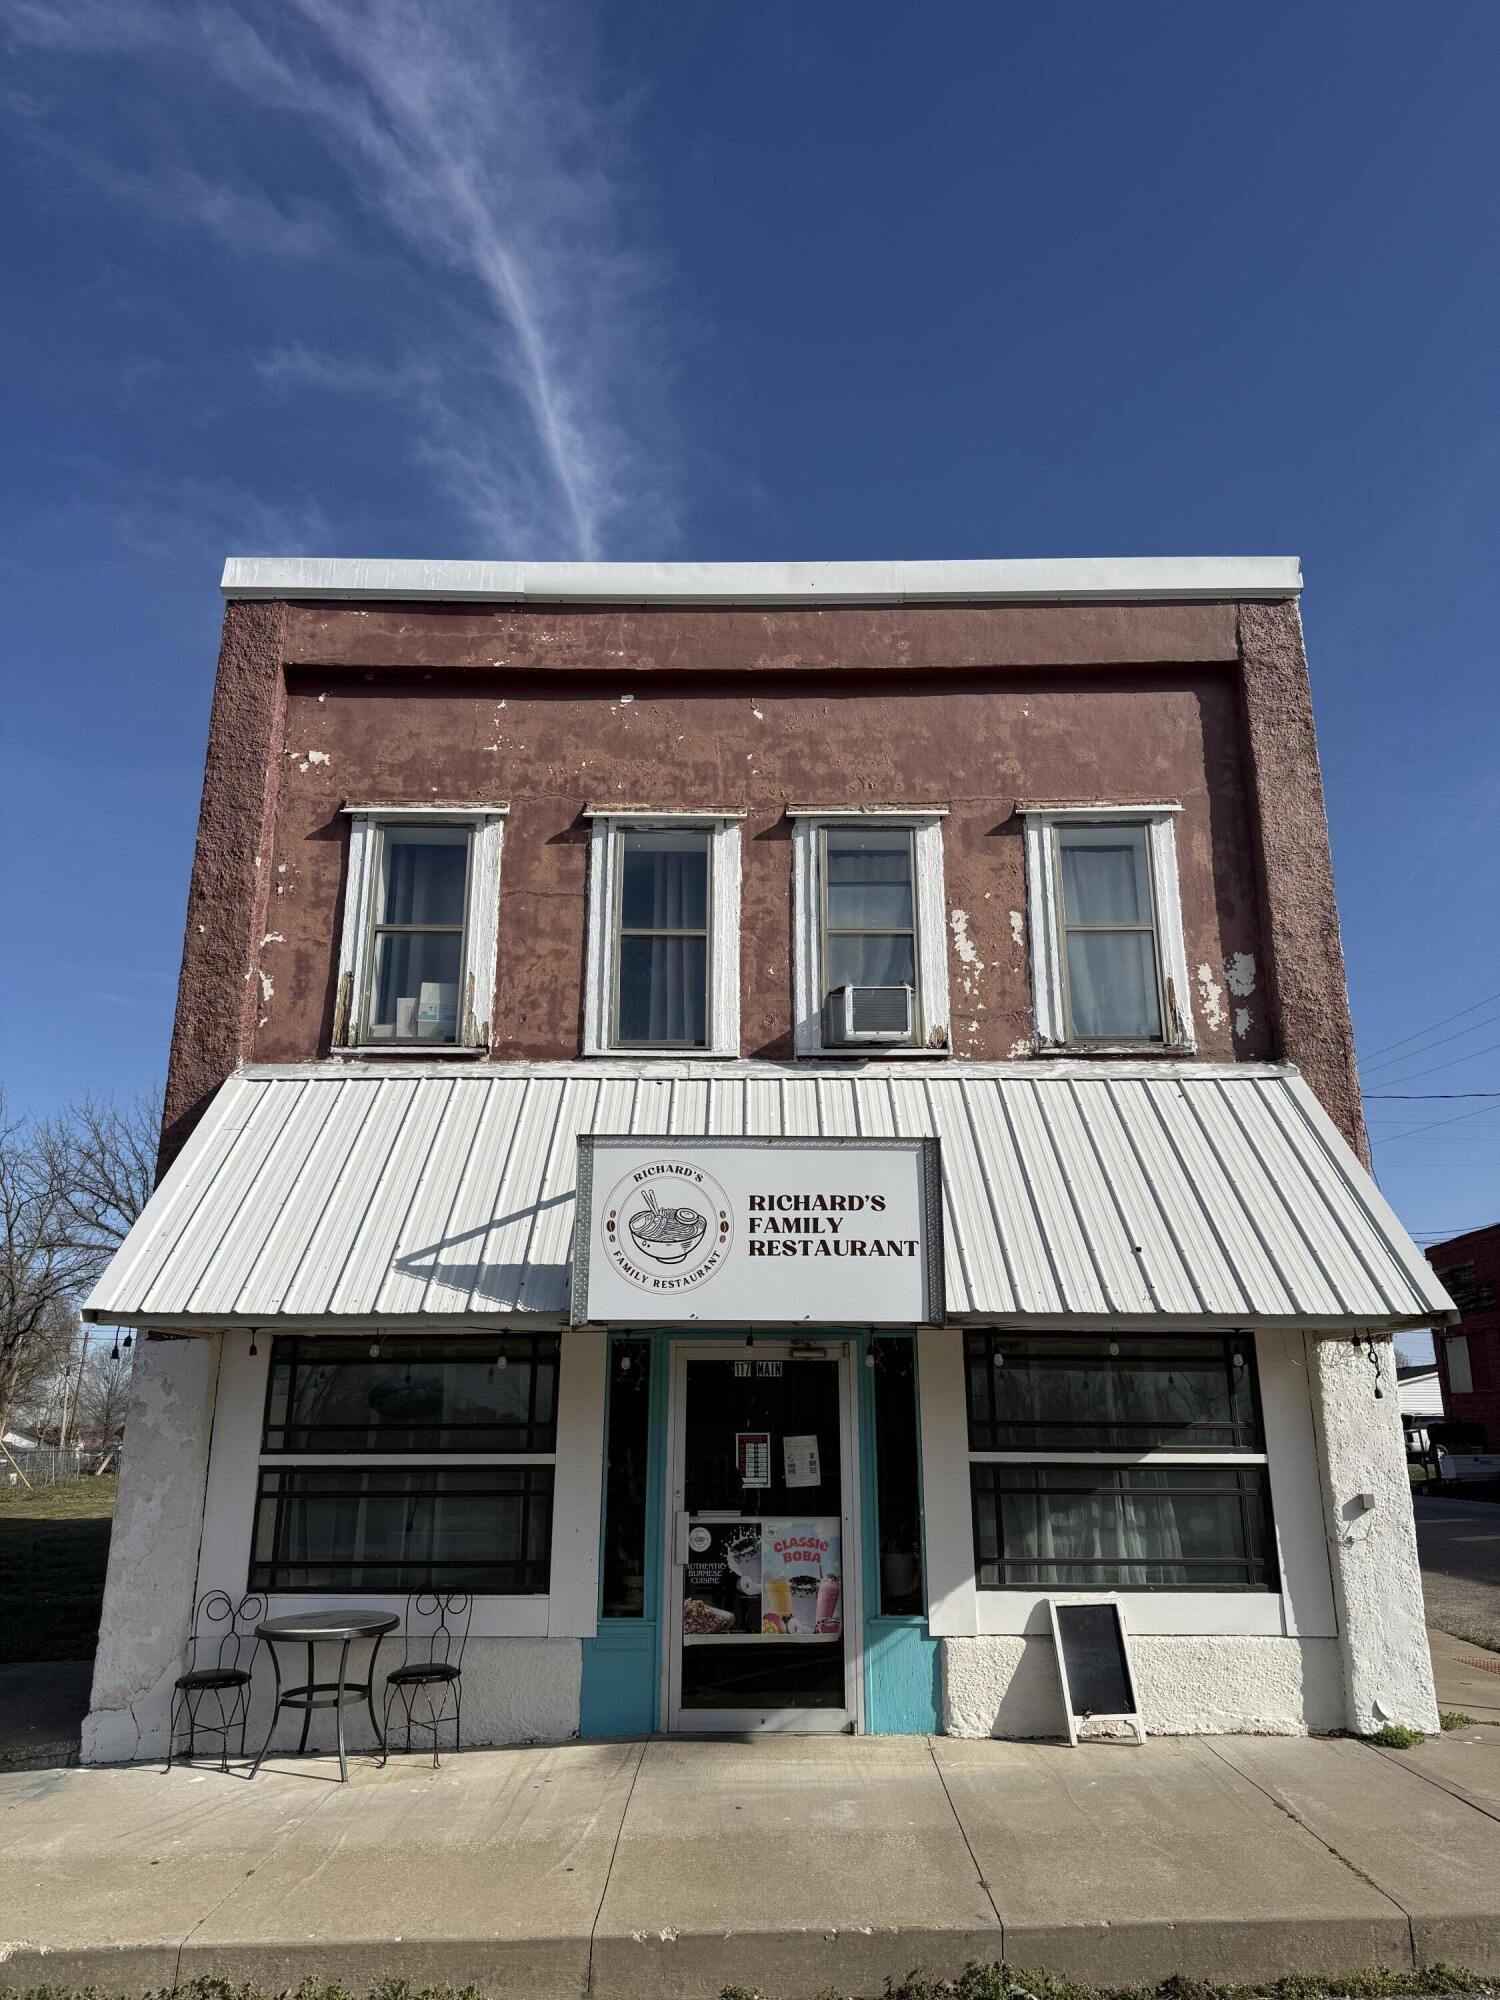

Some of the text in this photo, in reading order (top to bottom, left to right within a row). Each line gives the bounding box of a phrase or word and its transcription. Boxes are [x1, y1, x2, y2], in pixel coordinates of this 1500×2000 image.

[633, 1165, 704, 1182] RICHARD'S
[748, 1194, 886, 1212] RICHARD'S
[748, 1217, 843, 1234] FAMILY
[748, 1239, 919, 1257] RESTAURANT
[613, 1250, 721, 1289] FAMILY RESTAURANT
[735, 1361, 782, 1377] 117 MAIN
[773, 1536, 829, 1553] CLASSIC
[686, 1562, 726, 1570] AUTHENTIC
[783, 1551, 821, 1564] BOBA
